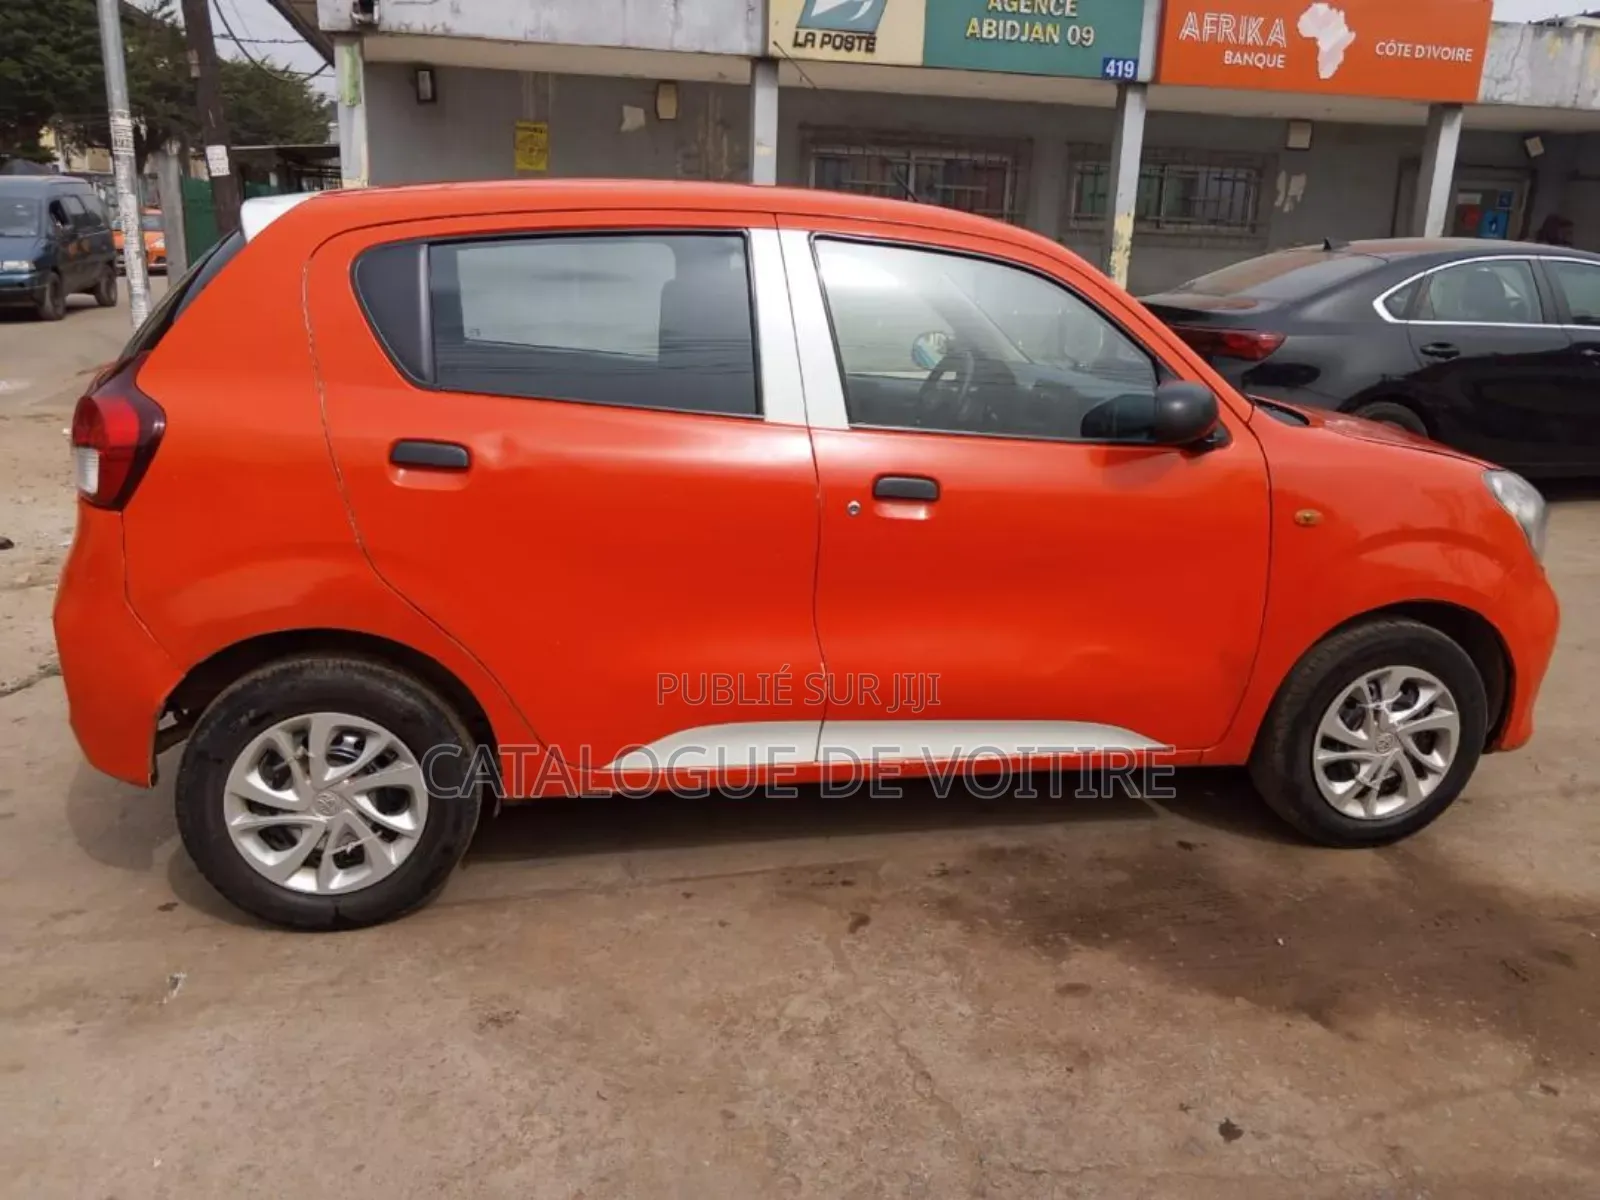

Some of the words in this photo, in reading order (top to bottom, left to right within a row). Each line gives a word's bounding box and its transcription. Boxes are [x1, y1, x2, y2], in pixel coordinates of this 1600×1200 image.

[987, 0, 1079, 17] AGENCE
[966, 17, 1060, 46] ABIDJAN
[1066, 24, 1096, 47] 09
[1178, 11, 1288, 48] AFRIKA
[793, 30, 816, 49] LA
[819, 31, 877, 53] POSTE
[1375, 40, 1412, 59] CÔTE
[1415, 43, 1474, 62] D'IVOIRE
[1104, 58, 1136, 79] 419
[1223, 50, 1287, 70] BANQUE
